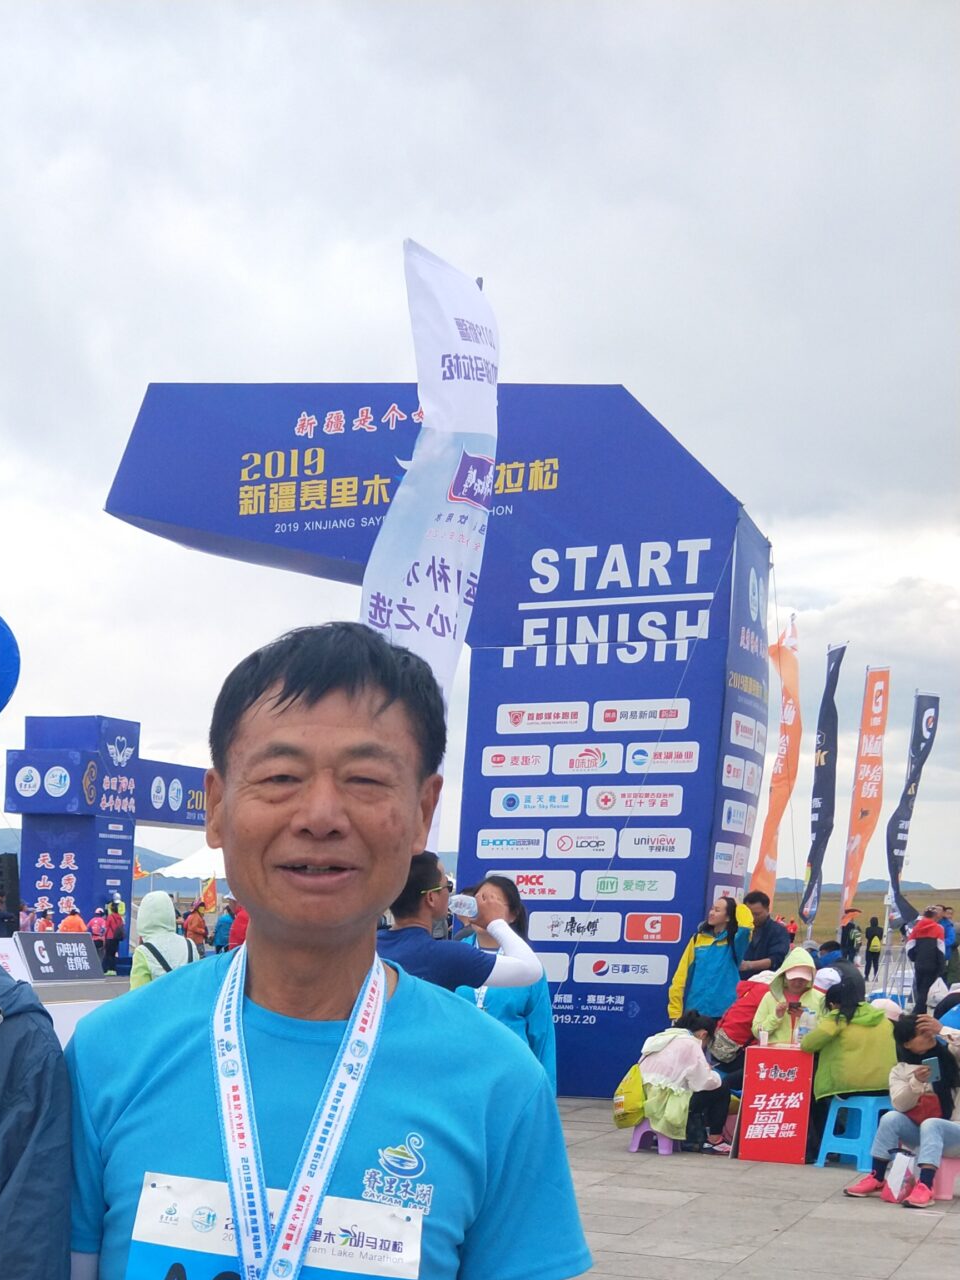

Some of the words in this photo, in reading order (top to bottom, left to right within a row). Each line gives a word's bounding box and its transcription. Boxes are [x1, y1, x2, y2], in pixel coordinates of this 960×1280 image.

[240, 446, 326, 481] 2019
[274, 520, 299, 534] 2019
[303, 517, 356, 531] XINJIANG
[528, 538, 712, 594] START
[502, 609, 710, 668] FINISH
[527, 711, 579, 721] 首都媒体跑团
[619, 709, 658, 720] 网易新闻
[524, 794, 569, 803] 蓝天救援
[625, 799, 669, 808] 红十字会
[575, 839, 606, 849] LOOP
[633, 834, 676, 846] uniview
[516, 874, 545, 886] PICC
[622, 879, 659, 892] 爱奇艺
[611, 963, 649, 974] 百事可乐
[554, 993, 573, 1004] 新疆
[586, 994, 625, 1005] 赛里木湖
[552, 1014, 597, 1025] 019.7.20
[749, 1092, 804, 1110] 马拉松
[753, 1111, 784, 1124] 运动
[745, 1124, 779, 1139] 膳食
[331, 1246, 354, 1259] Lake
[360, 1250, 405, 1264] Marathon
